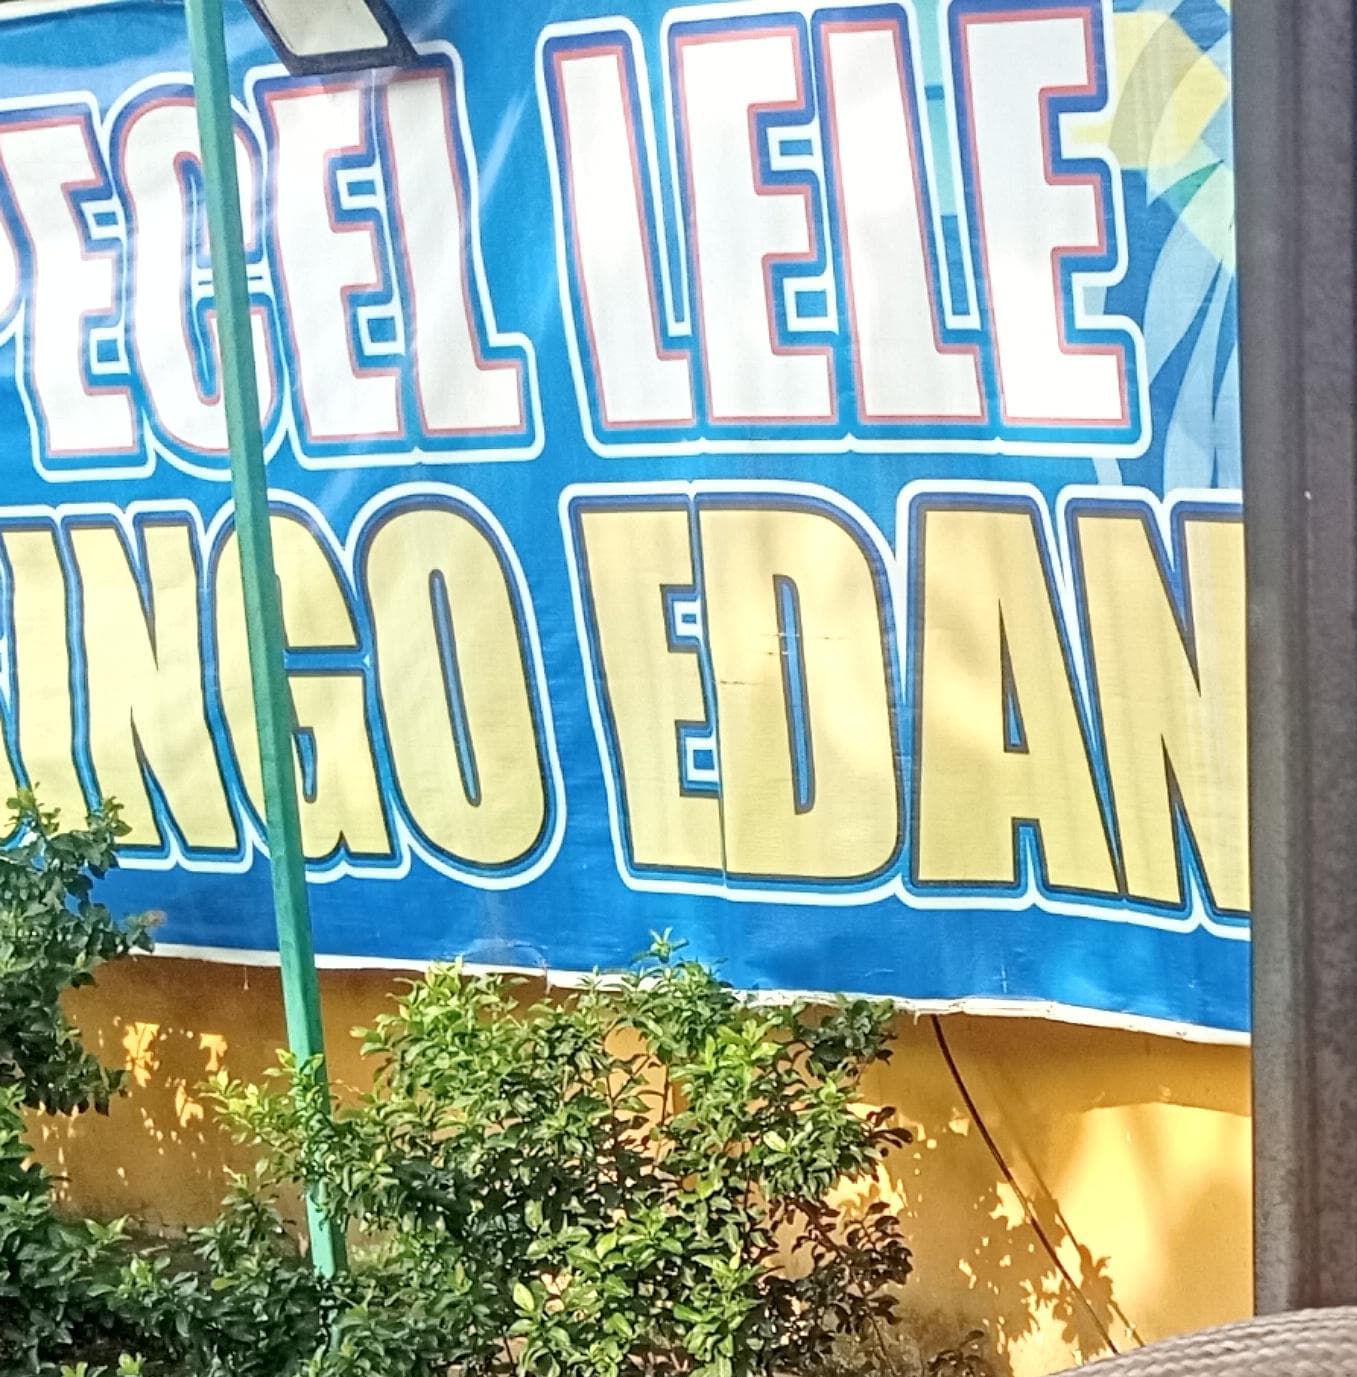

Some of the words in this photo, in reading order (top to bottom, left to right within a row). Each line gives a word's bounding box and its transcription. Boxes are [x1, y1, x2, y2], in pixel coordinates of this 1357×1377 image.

[0, 55, 540, 465] ECEL
[545, 6, 1142, 440] LELE
[0, 495, 557, 883] INGO
[572, 492, 1250, 917] EDAN
